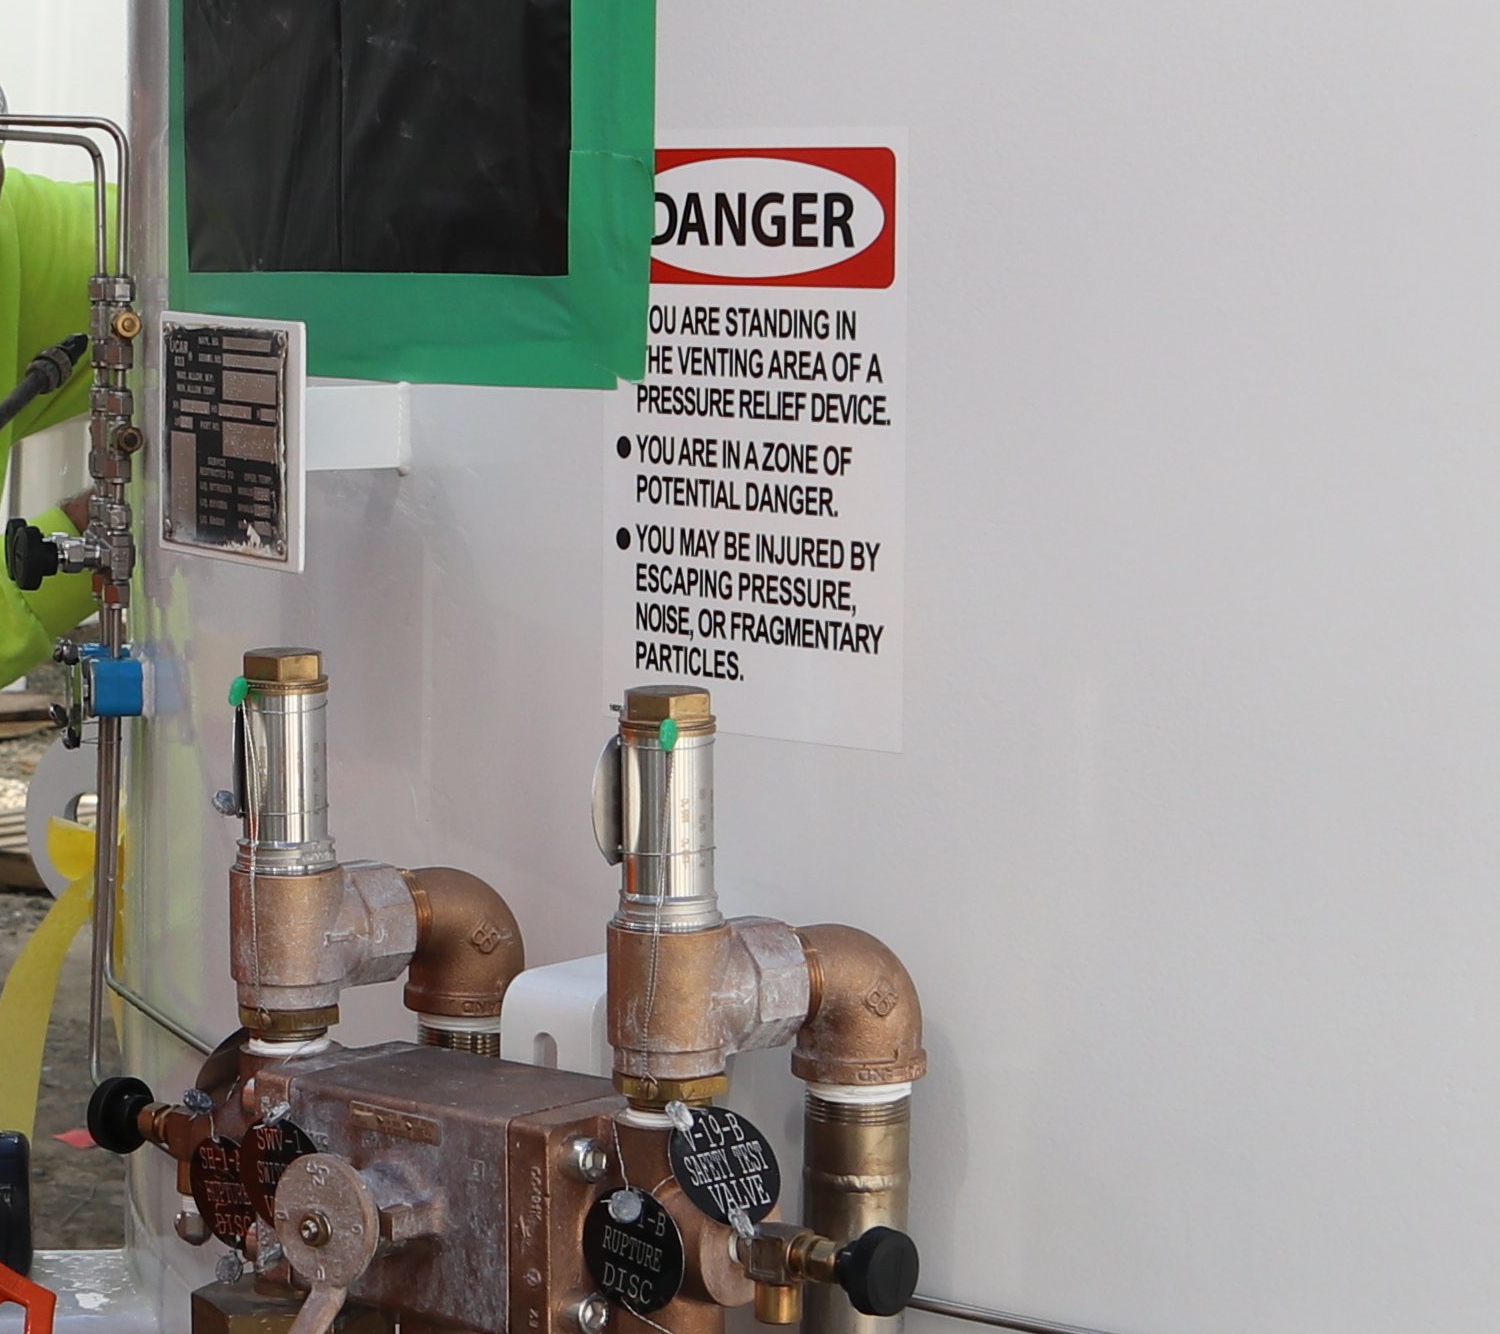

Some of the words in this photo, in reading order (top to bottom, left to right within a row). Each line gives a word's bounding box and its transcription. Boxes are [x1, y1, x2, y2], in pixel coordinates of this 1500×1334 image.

[647, 305, 675, 334] OU
[680, 306, 720, 335] ARE
[725, 307, 829, 339] STANDING
[836, 310, 855, 340] IN
[644, 342, 672, 374] HE
[678, 346, 763, 378] VENTING
[768, 350, 827, 380] AREA
[832, 352, 861, 382] OF
[866, 353, 882, 383] A
[637, 383, 734, 417] PRESSURE
[739, 389, 806, 421] RELIEF
[811, 393, 890, 425] DEVICE.
[636, 435, 674, 465] YOU
[678, 437, 717, 467] ARE
[723, 440, 740, 469] IN
[744, 441, 758, 470] A
[762, 442, 817, 474] ZONE
[823, 445, 852, 475] OF
[637, 474, 740, 510] POTENTIAL
[746, 482, 837, 517] DANGER.
[636, 524, 674, 555] YOU
[680, 528, 719, 558] MAY
[724, 531, 750, 561] BE
[756, 534, 844, 569] INJURED
[851, 541, 880, 571] BY
[636, 563, 732, 600] ESCAPING
[739, 572, 855, 616] PRESSURE,
[636, 602, 693, 640] NOISE,
[698, 608, 726, 639] OR
[731, 611, 883, 654] FRAGMENTARY
[636, 641, 743, 680] PARTICLES.
[256, 1127, 304, 1154] SWV-1
[682, 1112, 745, 1152] V-19-B
[683, 1148, 735, 1187] SAFETY
[731, 1140, 769, 1174] TEST
[707, 1174, 771, 1214] VALVE
[602, 1224, 663, 1273] RUPTURE
[602, 1261, 653, 1305] DISC
